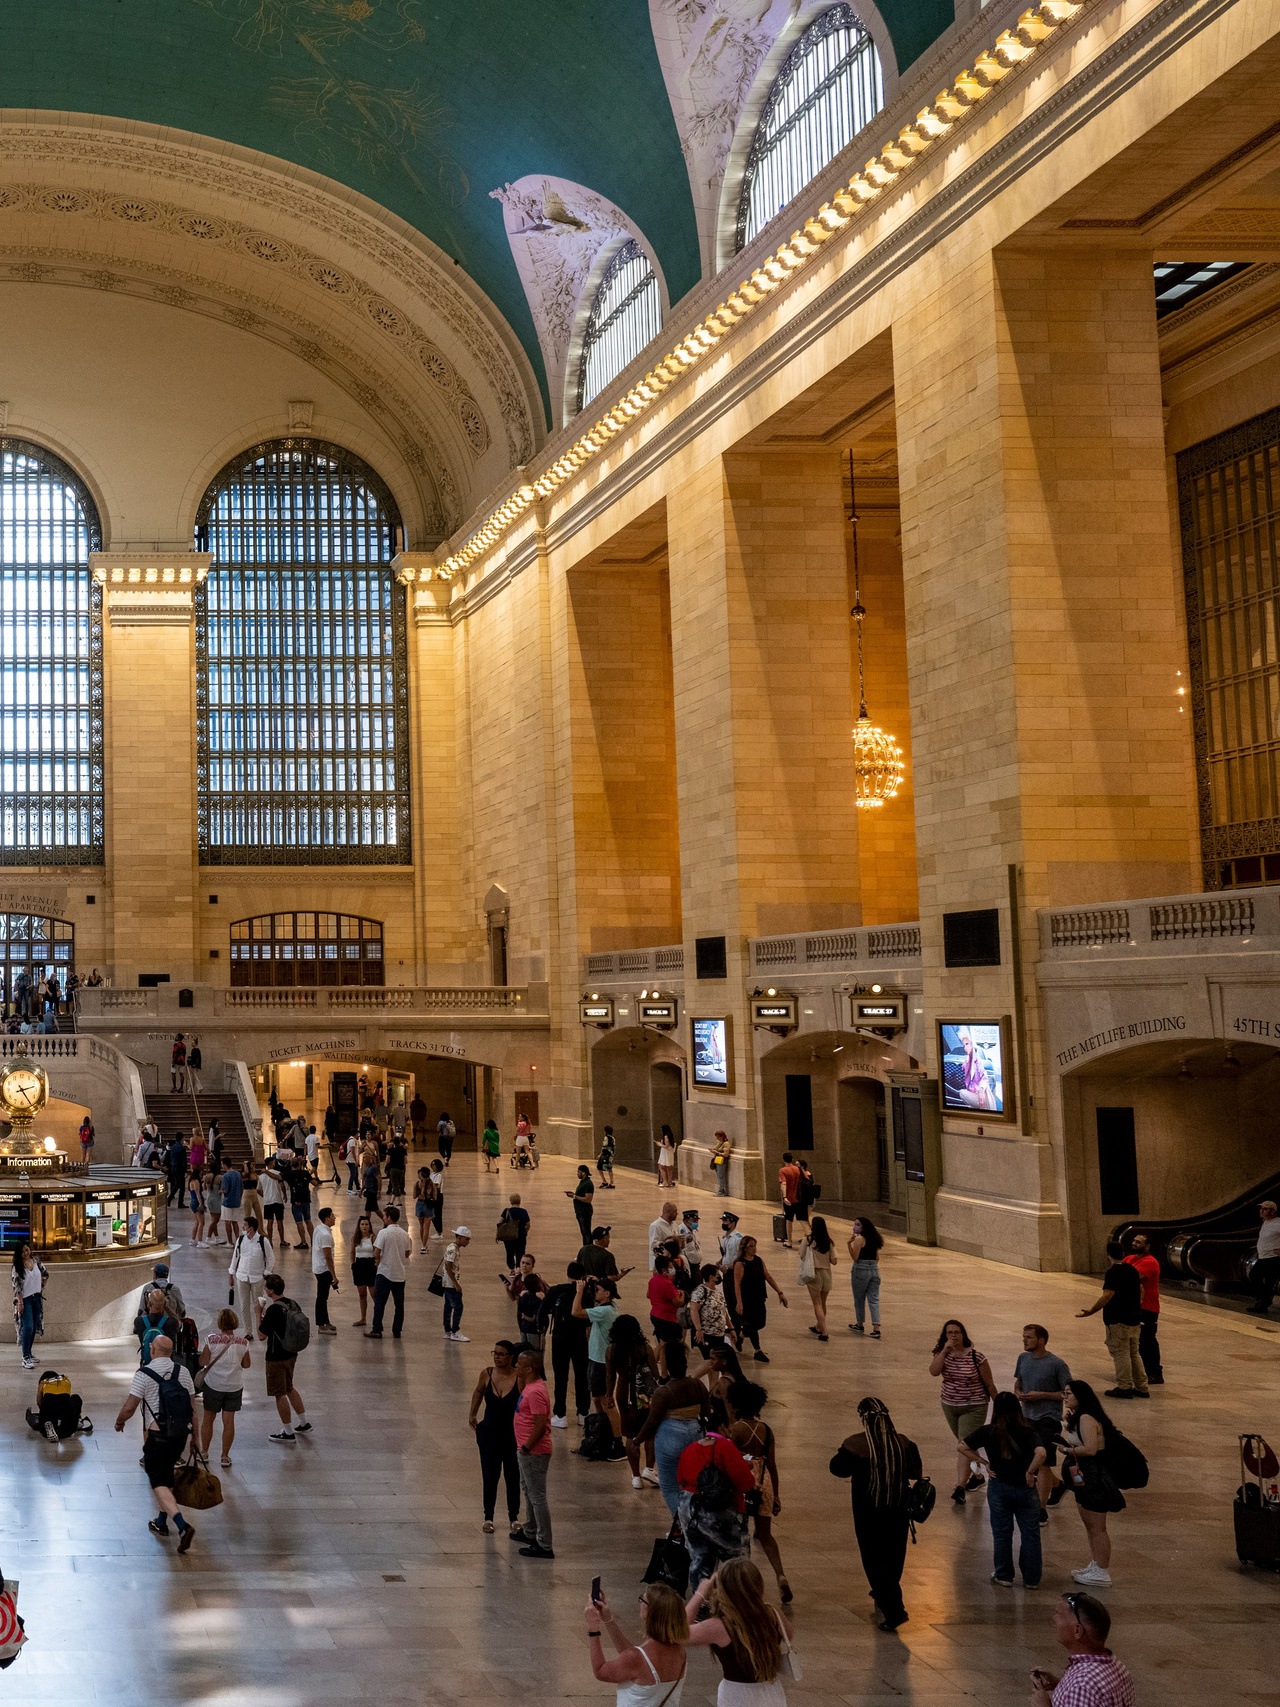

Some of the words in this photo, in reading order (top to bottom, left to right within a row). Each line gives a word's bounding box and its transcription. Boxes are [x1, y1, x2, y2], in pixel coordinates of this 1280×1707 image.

[20, 895, 59, 906] AVENUE
[9, 902, 65, 916] APARTMENT
[1233, 1018, 1270, 1036] 45TH
[389, 1040, 427, 1050] TRACKS
[441, 1045, 454, 1054] TO
[1056, 1045, 1078, 1066] THE
[1079, 1026, 1126, 1054] METLIFE
[1128, 1016, 1186, 1038] BUILDING
[268, 1045, 301, 1058] TICKET
[305, 1040, 355, 1051] MACHINES
[365, 1056, 388, 1064] ROOM
[7, 1157, 52, 1166] Information
